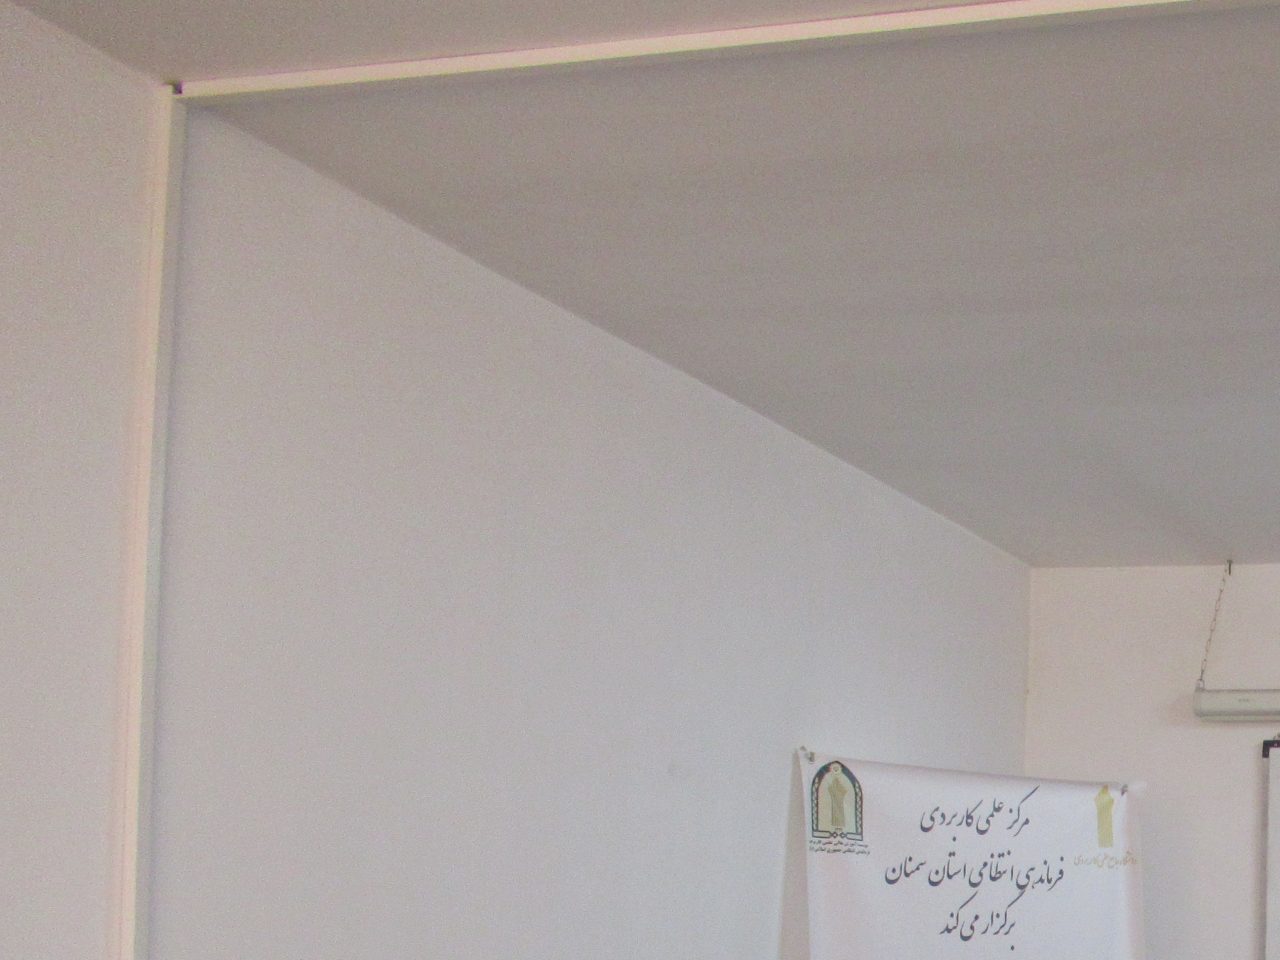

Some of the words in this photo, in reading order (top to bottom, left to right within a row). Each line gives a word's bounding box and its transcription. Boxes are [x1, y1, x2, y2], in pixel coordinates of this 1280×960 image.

[976, 797, 1004, 835] علمی
[1006, 785, 1040, 837] مرکز
[885, 856, 927, 885] سمنان
[928, 851, 967, 886] استان
[968, 850, 1014, 888] انتظامی
[1015, 855, 1065, 891] فرماندهی
